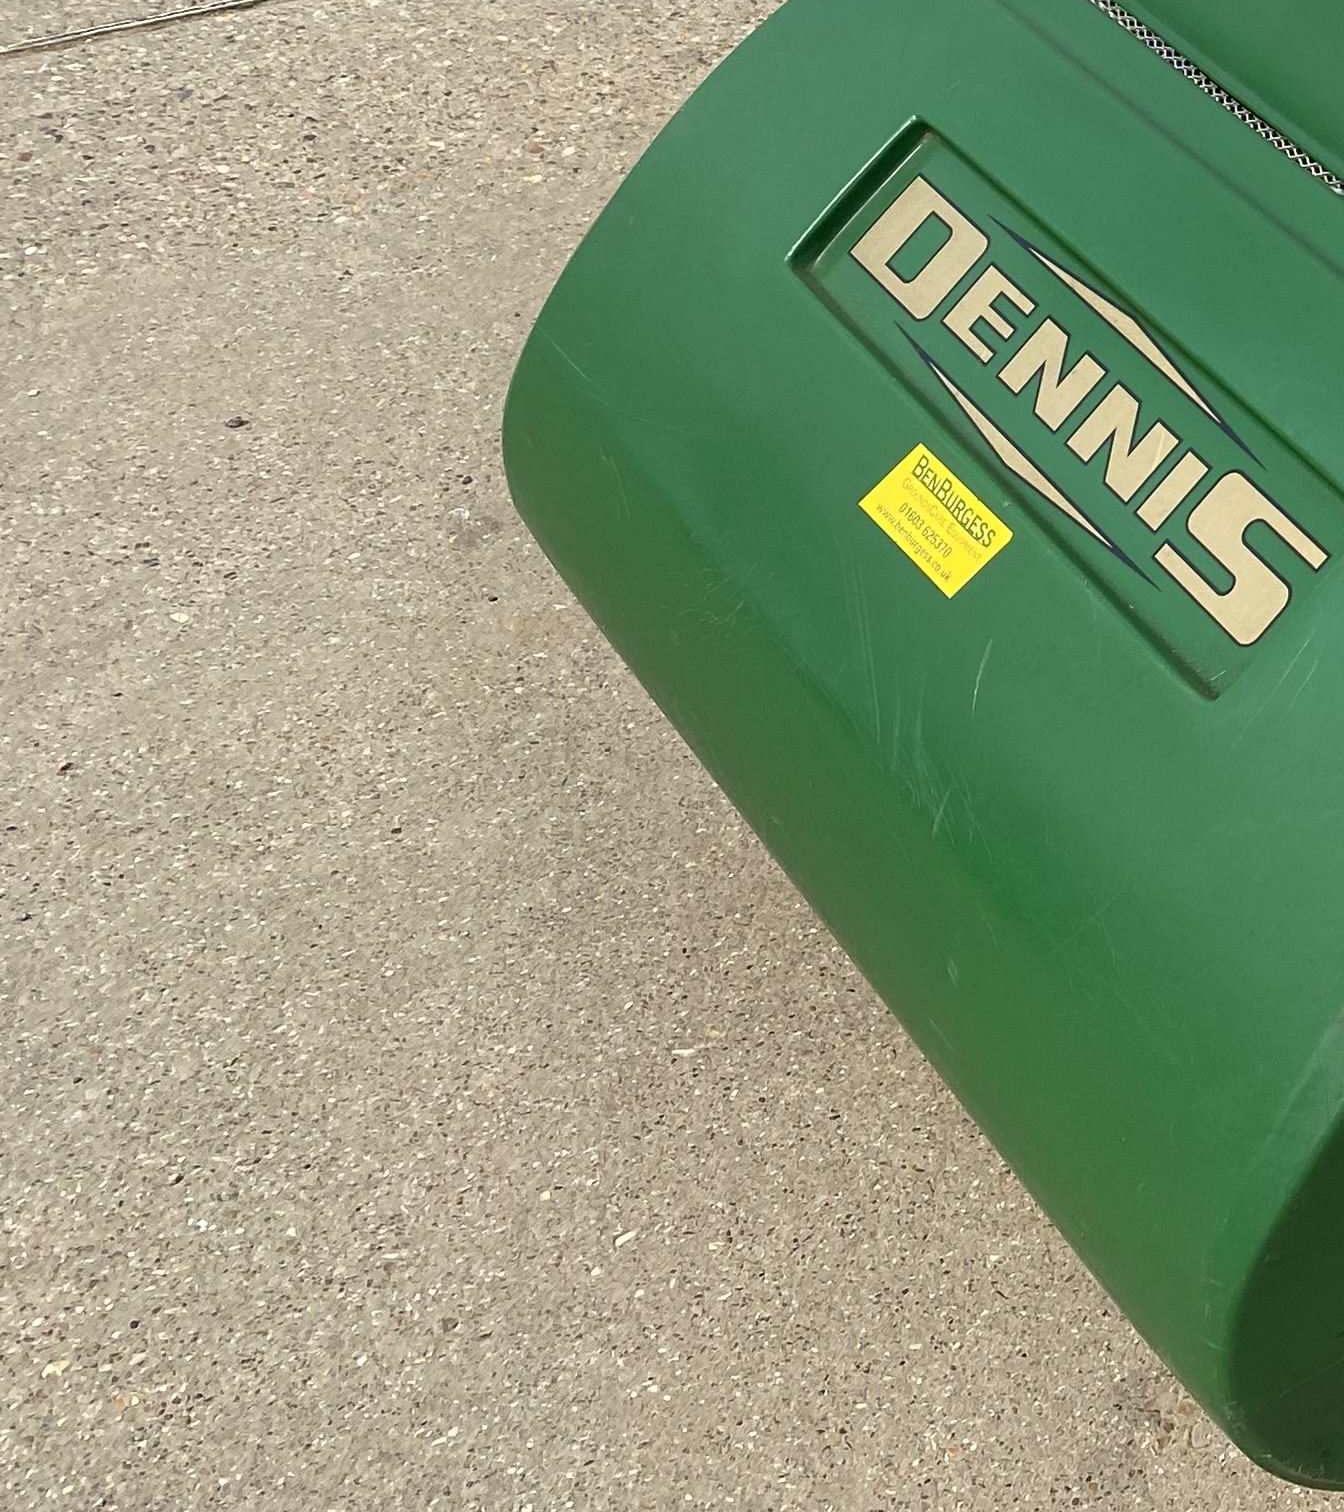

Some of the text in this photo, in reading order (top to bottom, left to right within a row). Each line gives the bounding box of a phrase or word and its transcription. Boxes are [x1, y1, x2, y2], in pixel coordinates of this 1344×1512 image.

[848, 174, 1333, 648] DENNIS
[876, 503, 952, 583] www.benburgess.co.uk
[899, 502, 953, 559] 01603 625370
